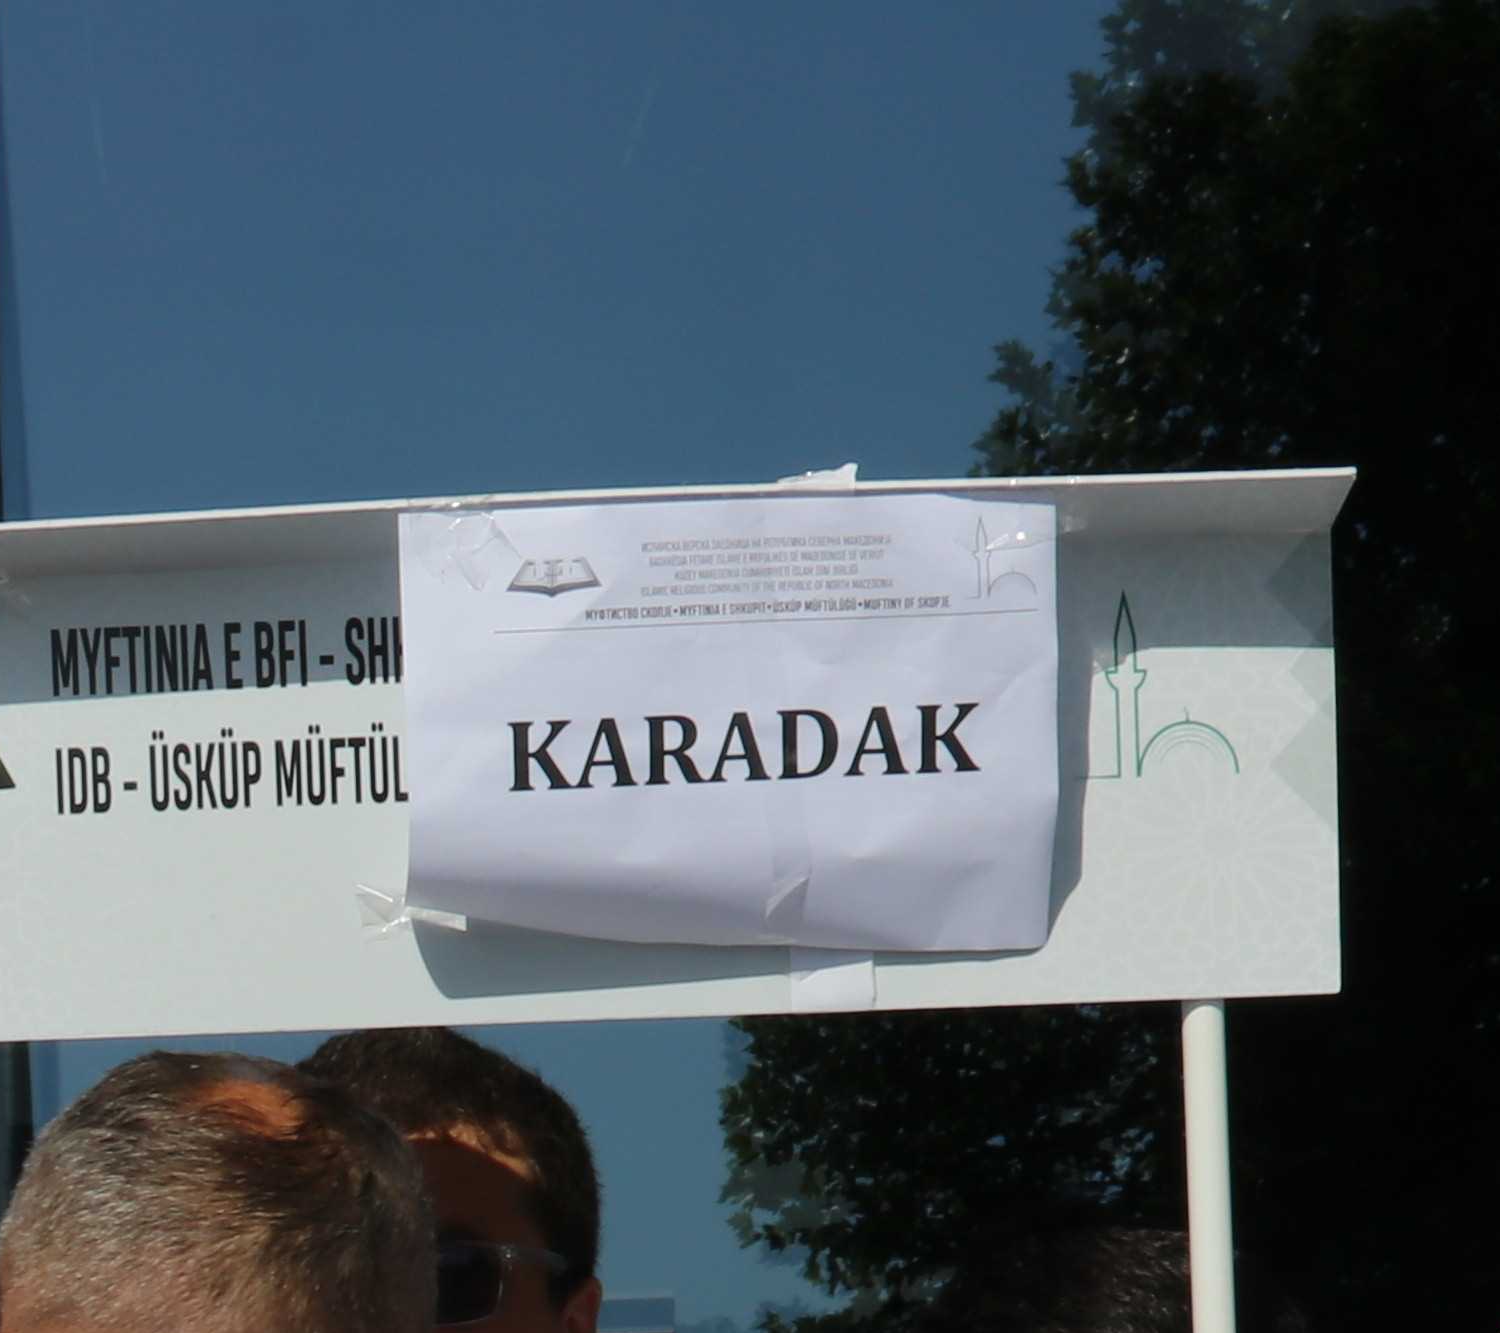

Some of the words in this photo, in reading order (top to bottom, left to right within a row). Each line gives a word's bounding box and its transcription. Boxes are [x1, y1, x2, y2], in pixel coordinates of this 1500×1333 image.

[50, 622, 214, 697] MYFTINIA
[223, 622, 243, 690] E
[253, 619, 308, 689] BFI
[55, 746, 112, 815] IDB
[148, 728, 261, 811] ÜSKÜP
[508, 702, 982, 792] KARADAK
